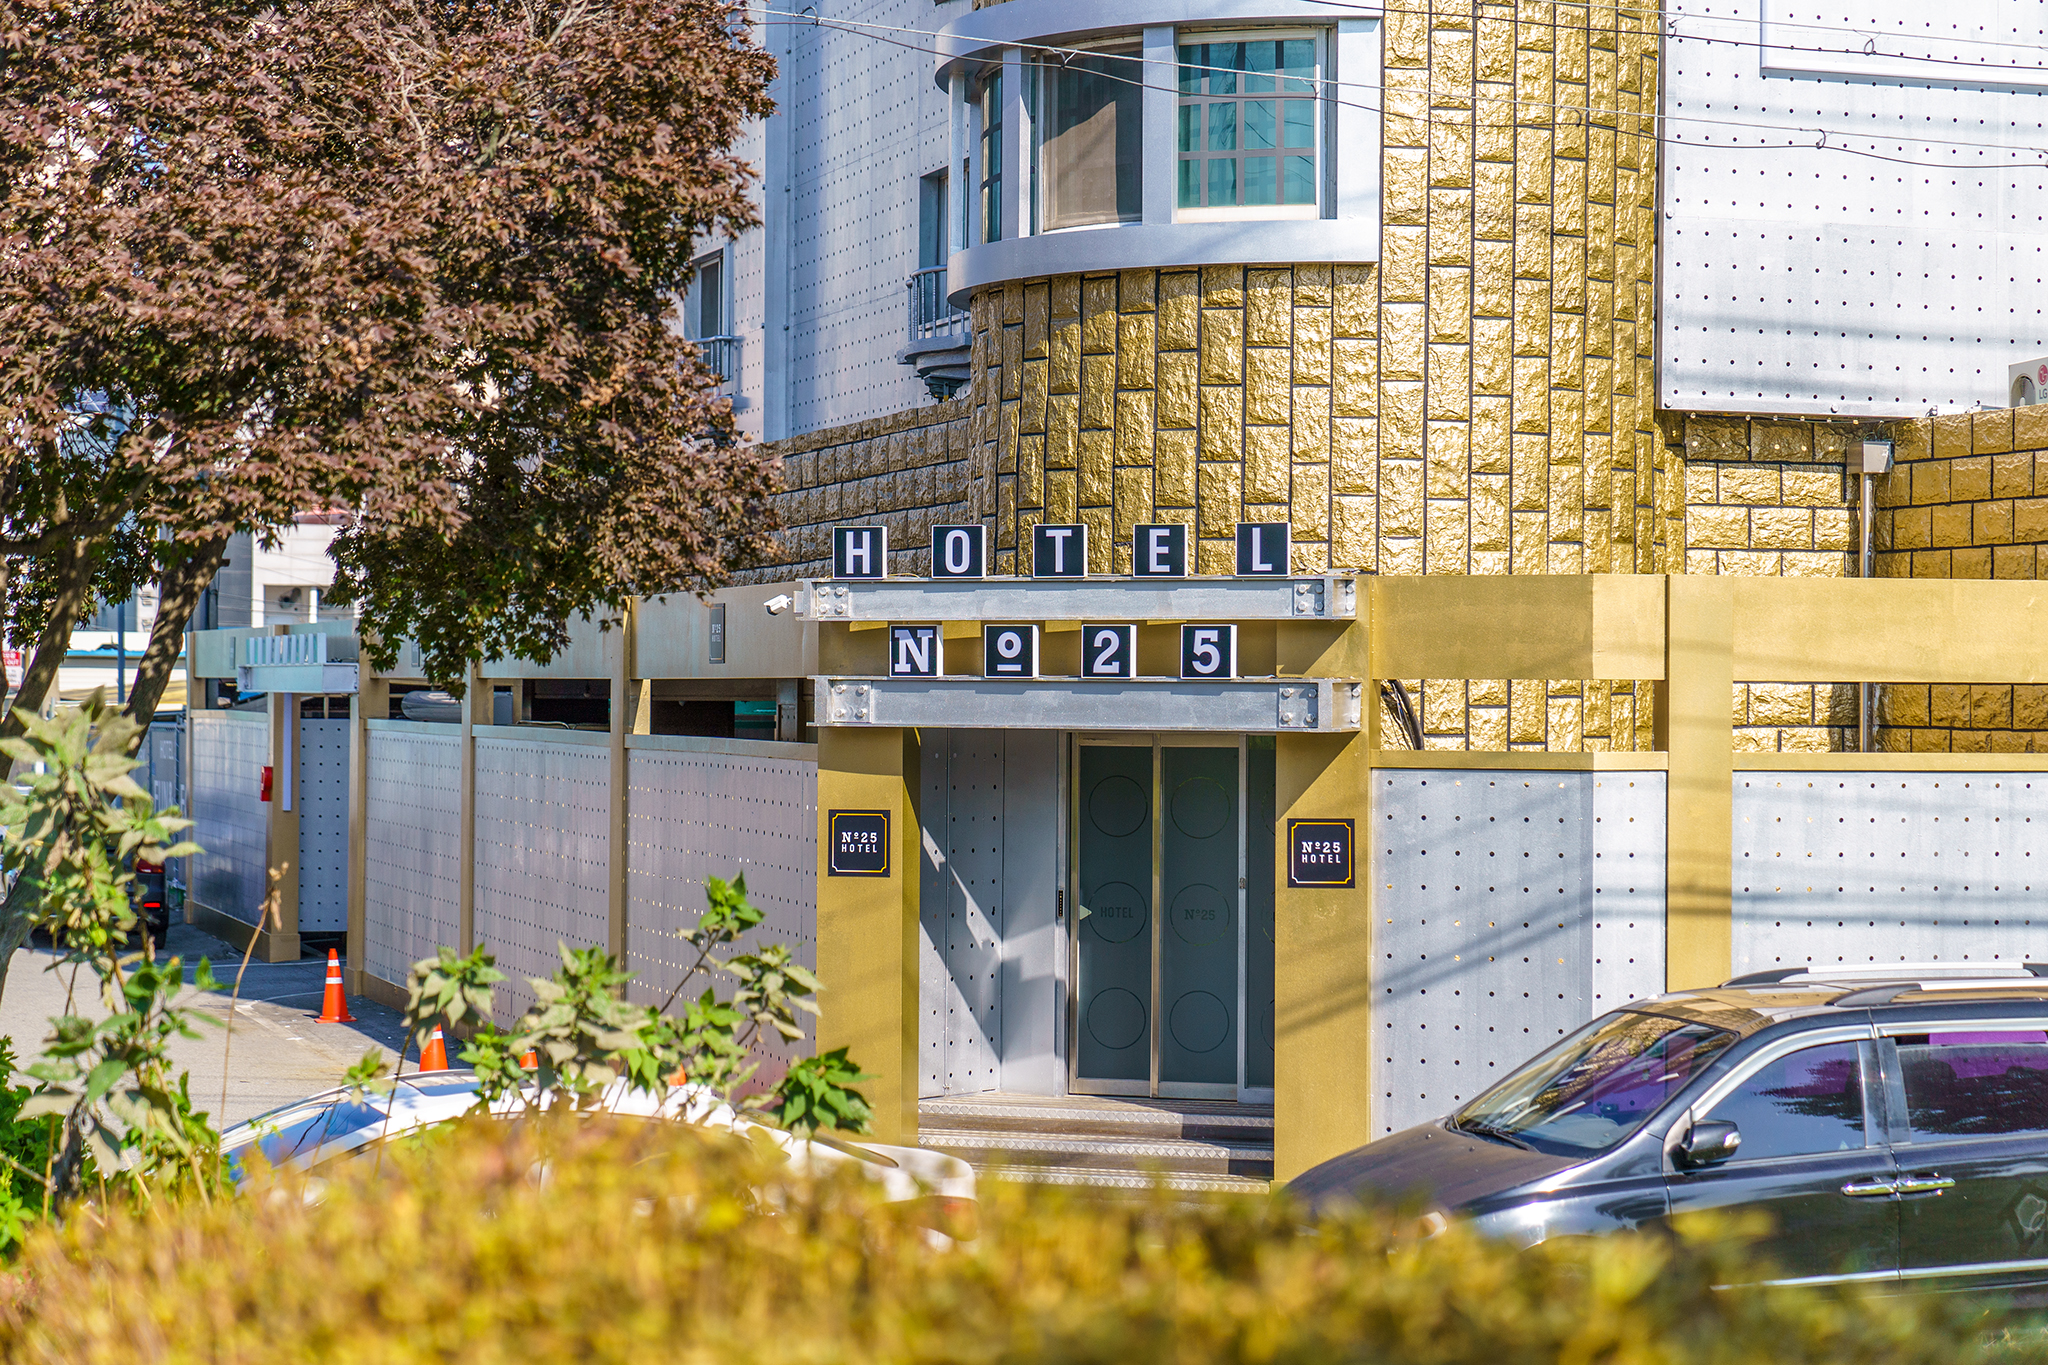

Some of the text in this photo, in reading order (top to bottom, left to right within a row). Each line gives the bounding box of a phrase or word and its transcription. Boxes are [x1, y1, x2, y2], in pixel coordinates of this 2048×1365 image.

[2039, 388, 2048, 399] LG
[846, 526, 1273, 574] HOTEL
[841, 843, 878, 853] HOTEL
[1301, 854, 1341, 864] HOTEL
[1100, 906, 1134, 919] HOTEL
